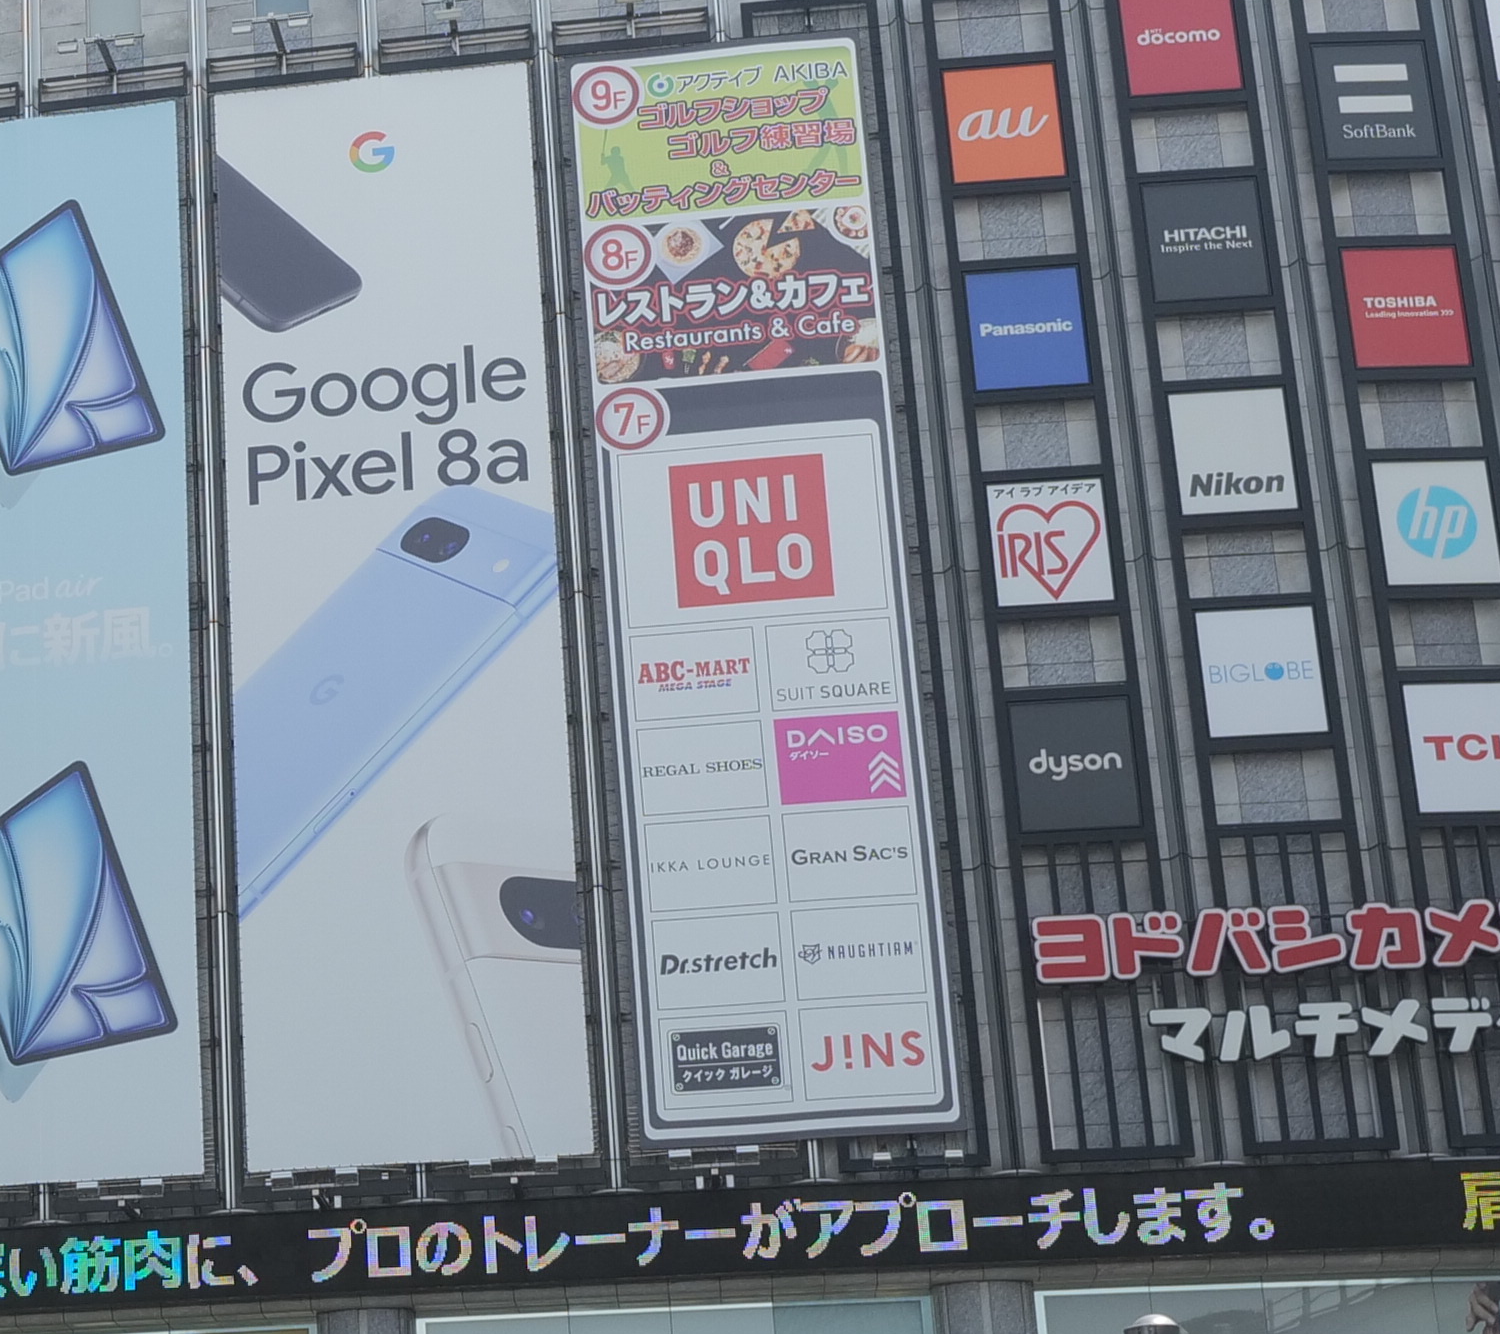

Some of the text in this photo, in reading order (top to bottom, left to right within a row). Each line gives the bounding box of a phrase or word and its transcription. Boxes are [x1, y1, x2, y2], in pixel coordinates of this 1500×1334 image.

[1137, 28, 1222, 46] docomo
[677, 60, 848, 94] アクティブ AKIBA
[638, 88, 829, 130] ゴルフショップ
[956, 105, 1050, 142] au
[1342, 124, 1417, 140] SoftBank
[669, 119, 857, 160] ゴルフ練習場
[586, 169, 862, 218] バッティングセンター
[1163, 224, 1247, 244] HITACHI
[1160, 241, 1200, 255] Inspire
[596, 273, 872, 327] レストラン&カフェ
[1363, 295, 1438, 308] TOSHIBA
[624, 312, 856, 354] Restaurants Cafe
[979, 318, 1073, 337] Panasonic
[242, 343, 527, 426] Google
[247, 428, 531, 506] Pixel 8a
[1189, 471, 1285, 498] Nikon
[688, 474, 798, 528] UNI
[692, 533, 814, 596] QLO
[638, 657, 751, 684] ABC-MART
[1208, 660, 1314, 685] BIGLOBE
[658, 680, 693, 693] MEGA
[776, 681, 891, 703] SUIT SQUARE
[786, 723, 888, 749] DAISO
[789, 749, 829, 762] ダイソー
[1029, 748, 1123, 781] dyson
[642, 759, 763, 779] REGAL SHOES
[650, 854, 771, 874] IKKA LOUNGE
[659, 947, 777, 976] Dr.stretch
[827, 941, 914, 960] NAUGHTIAM
[676, 1041, 774, 1063] Quick Garage
[682, 1064, 774, 1083] クイック ガレージ
[306, 1177, 1275, 1285] プロのトレーナーがアプローチします。
